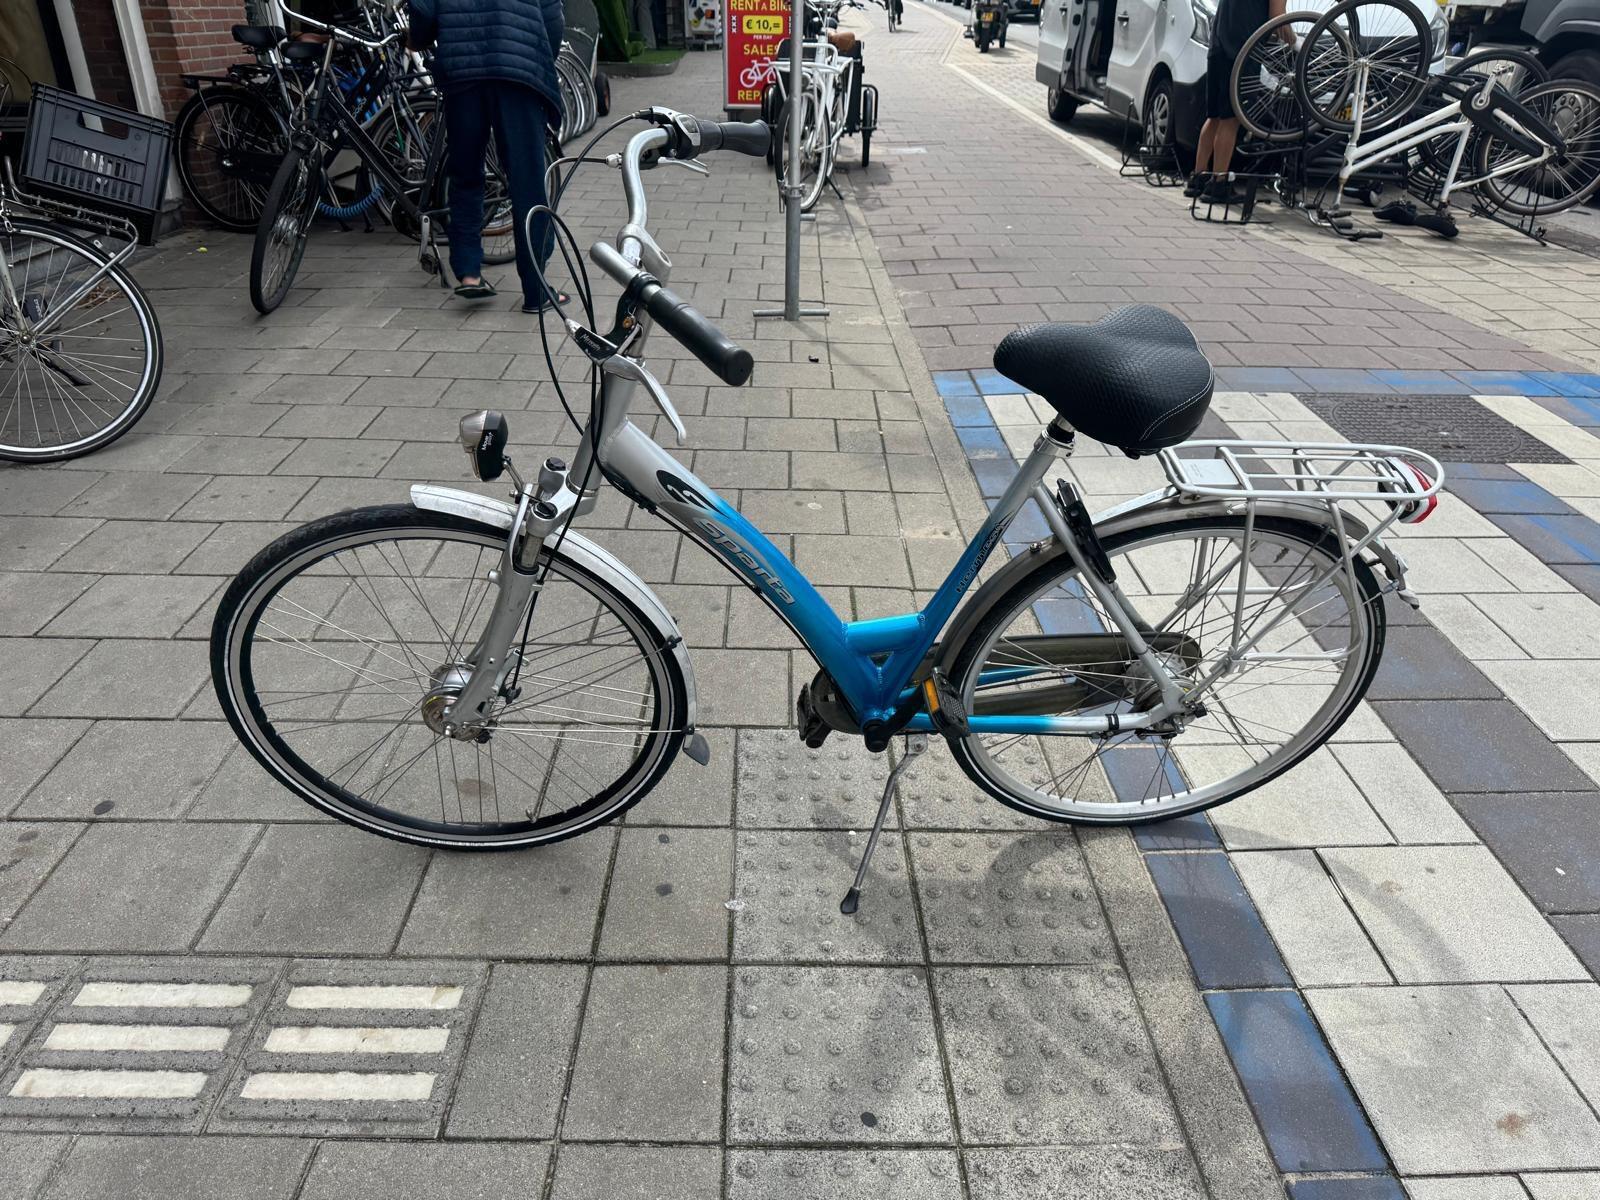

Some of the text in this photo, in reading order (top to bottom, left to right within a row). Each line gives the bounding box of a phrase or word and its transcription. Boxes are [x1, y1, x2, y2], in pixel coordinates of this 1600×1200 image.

[730, 0, 761, 11] RENT
[761, 3, 767, 11] A
[746, 19, 753, 29] €
[692, 519, 795, 604] Sparta
